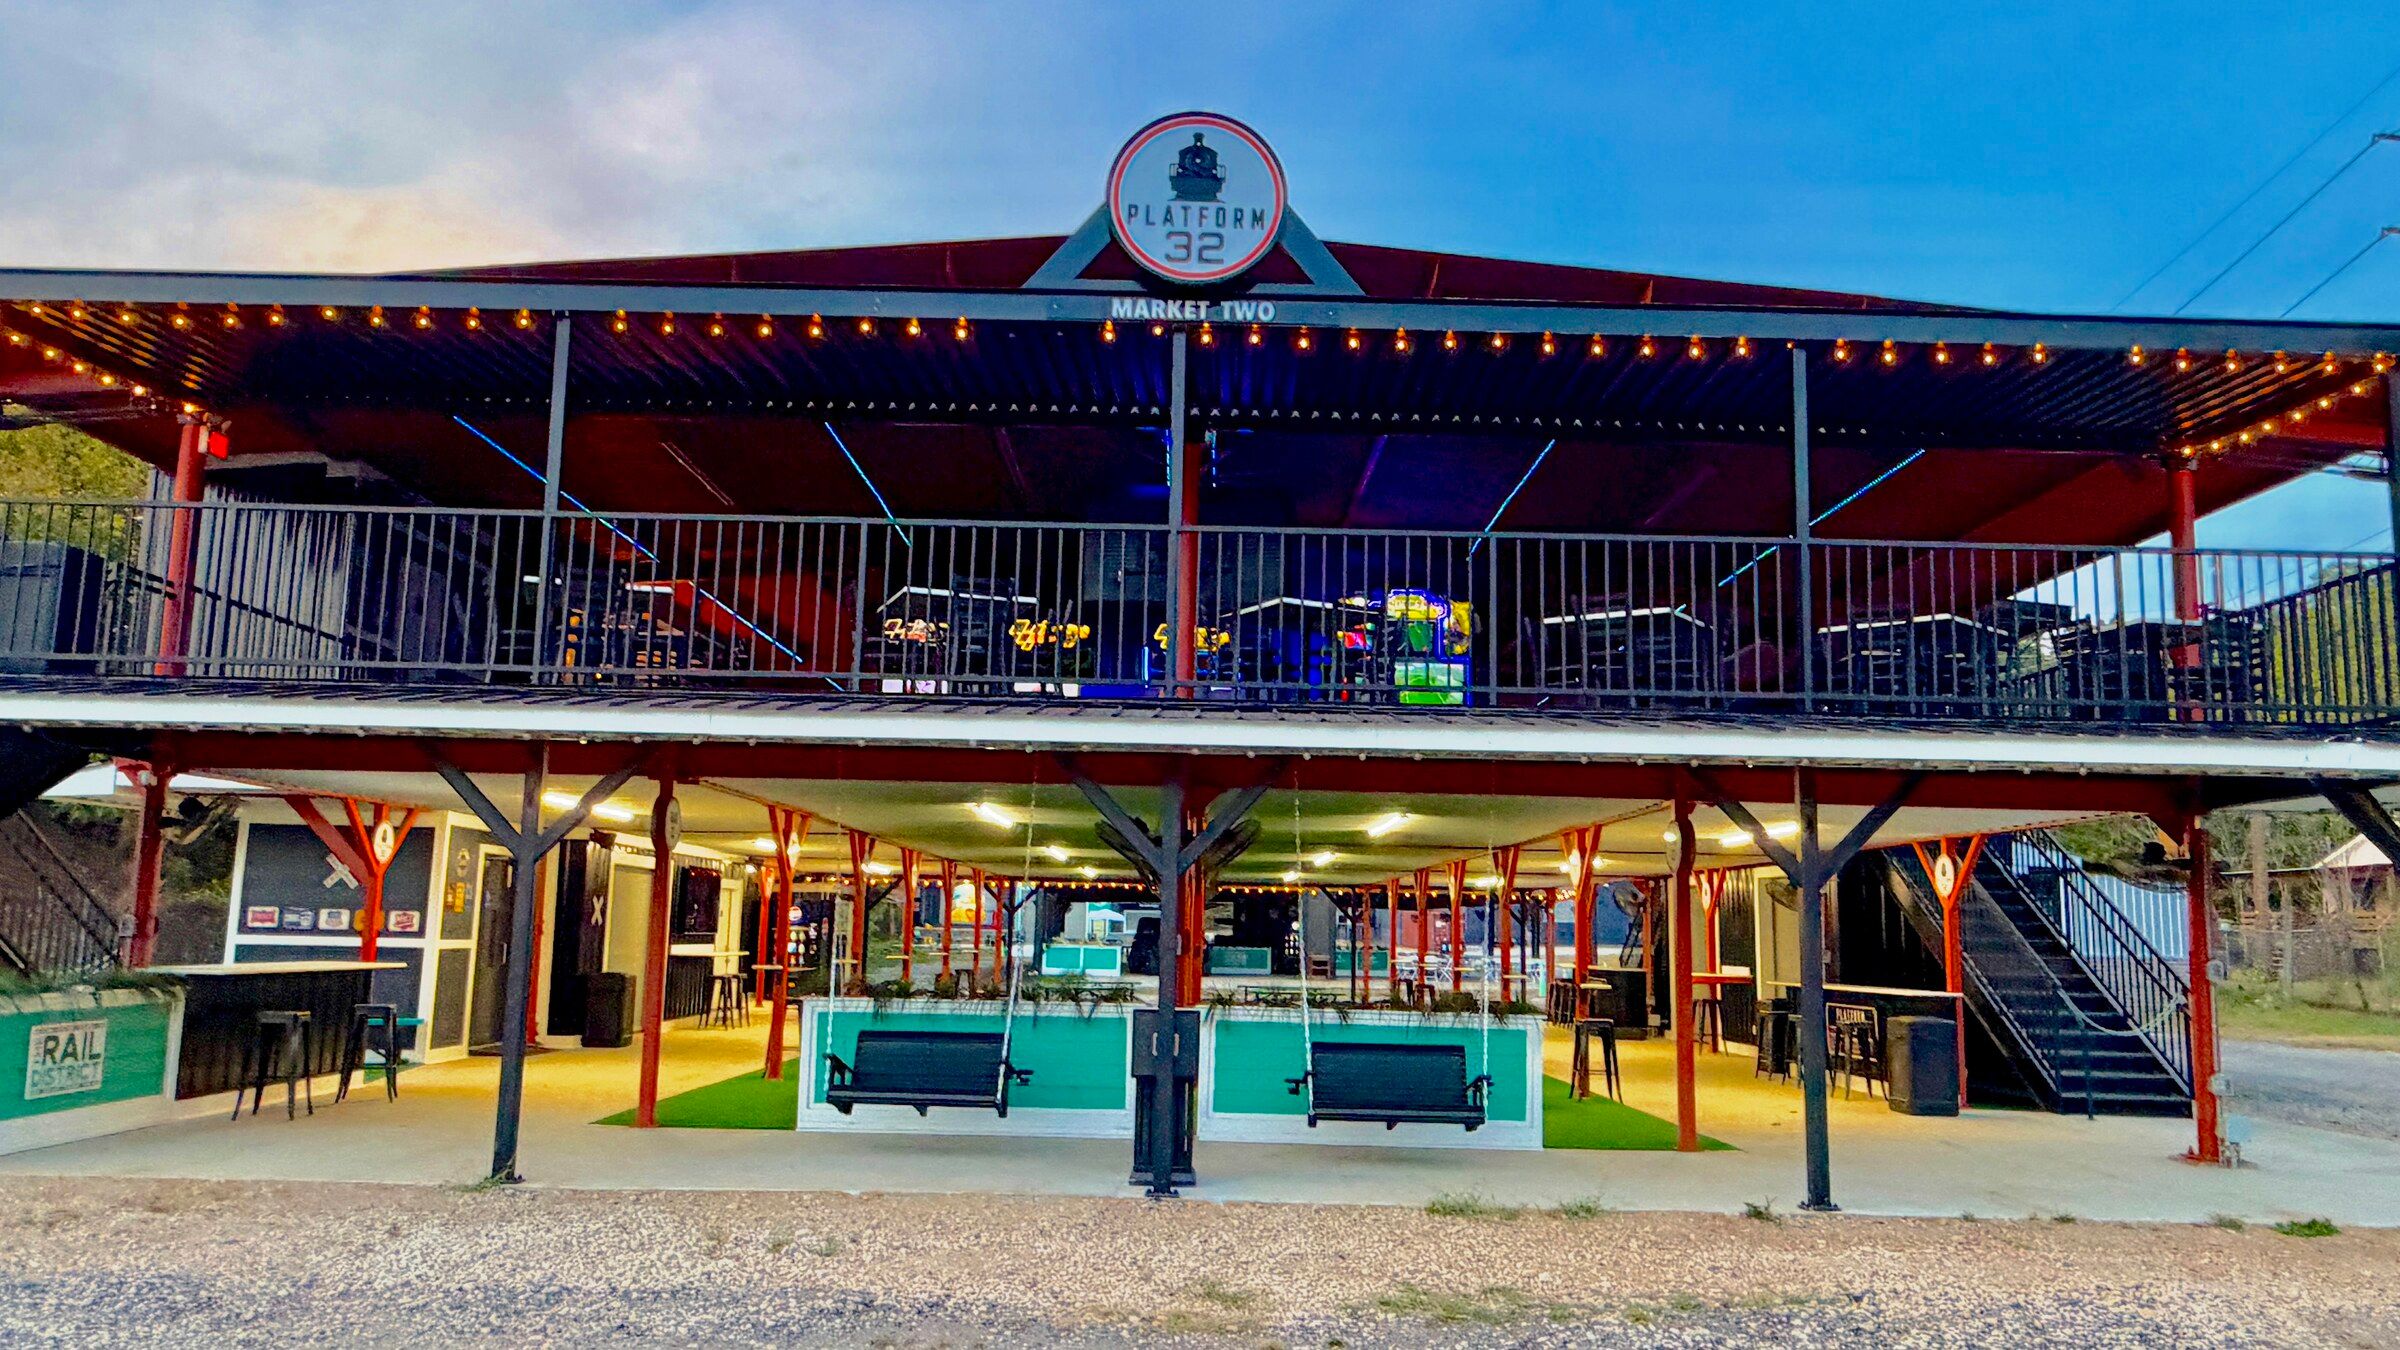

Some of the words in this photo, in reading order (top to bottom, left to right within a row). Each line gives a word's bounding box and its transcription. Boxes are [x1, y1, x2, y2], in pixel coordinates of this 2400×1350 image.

[1127, 204, 1265, 230] PLATFORM
[1165, 231, 1224, 264] 32
[1111, 298, 1210, 320] MARKET
[1221, 300, 1276, 322] TWO
[42, 1031, 101, 1065] RAIL
